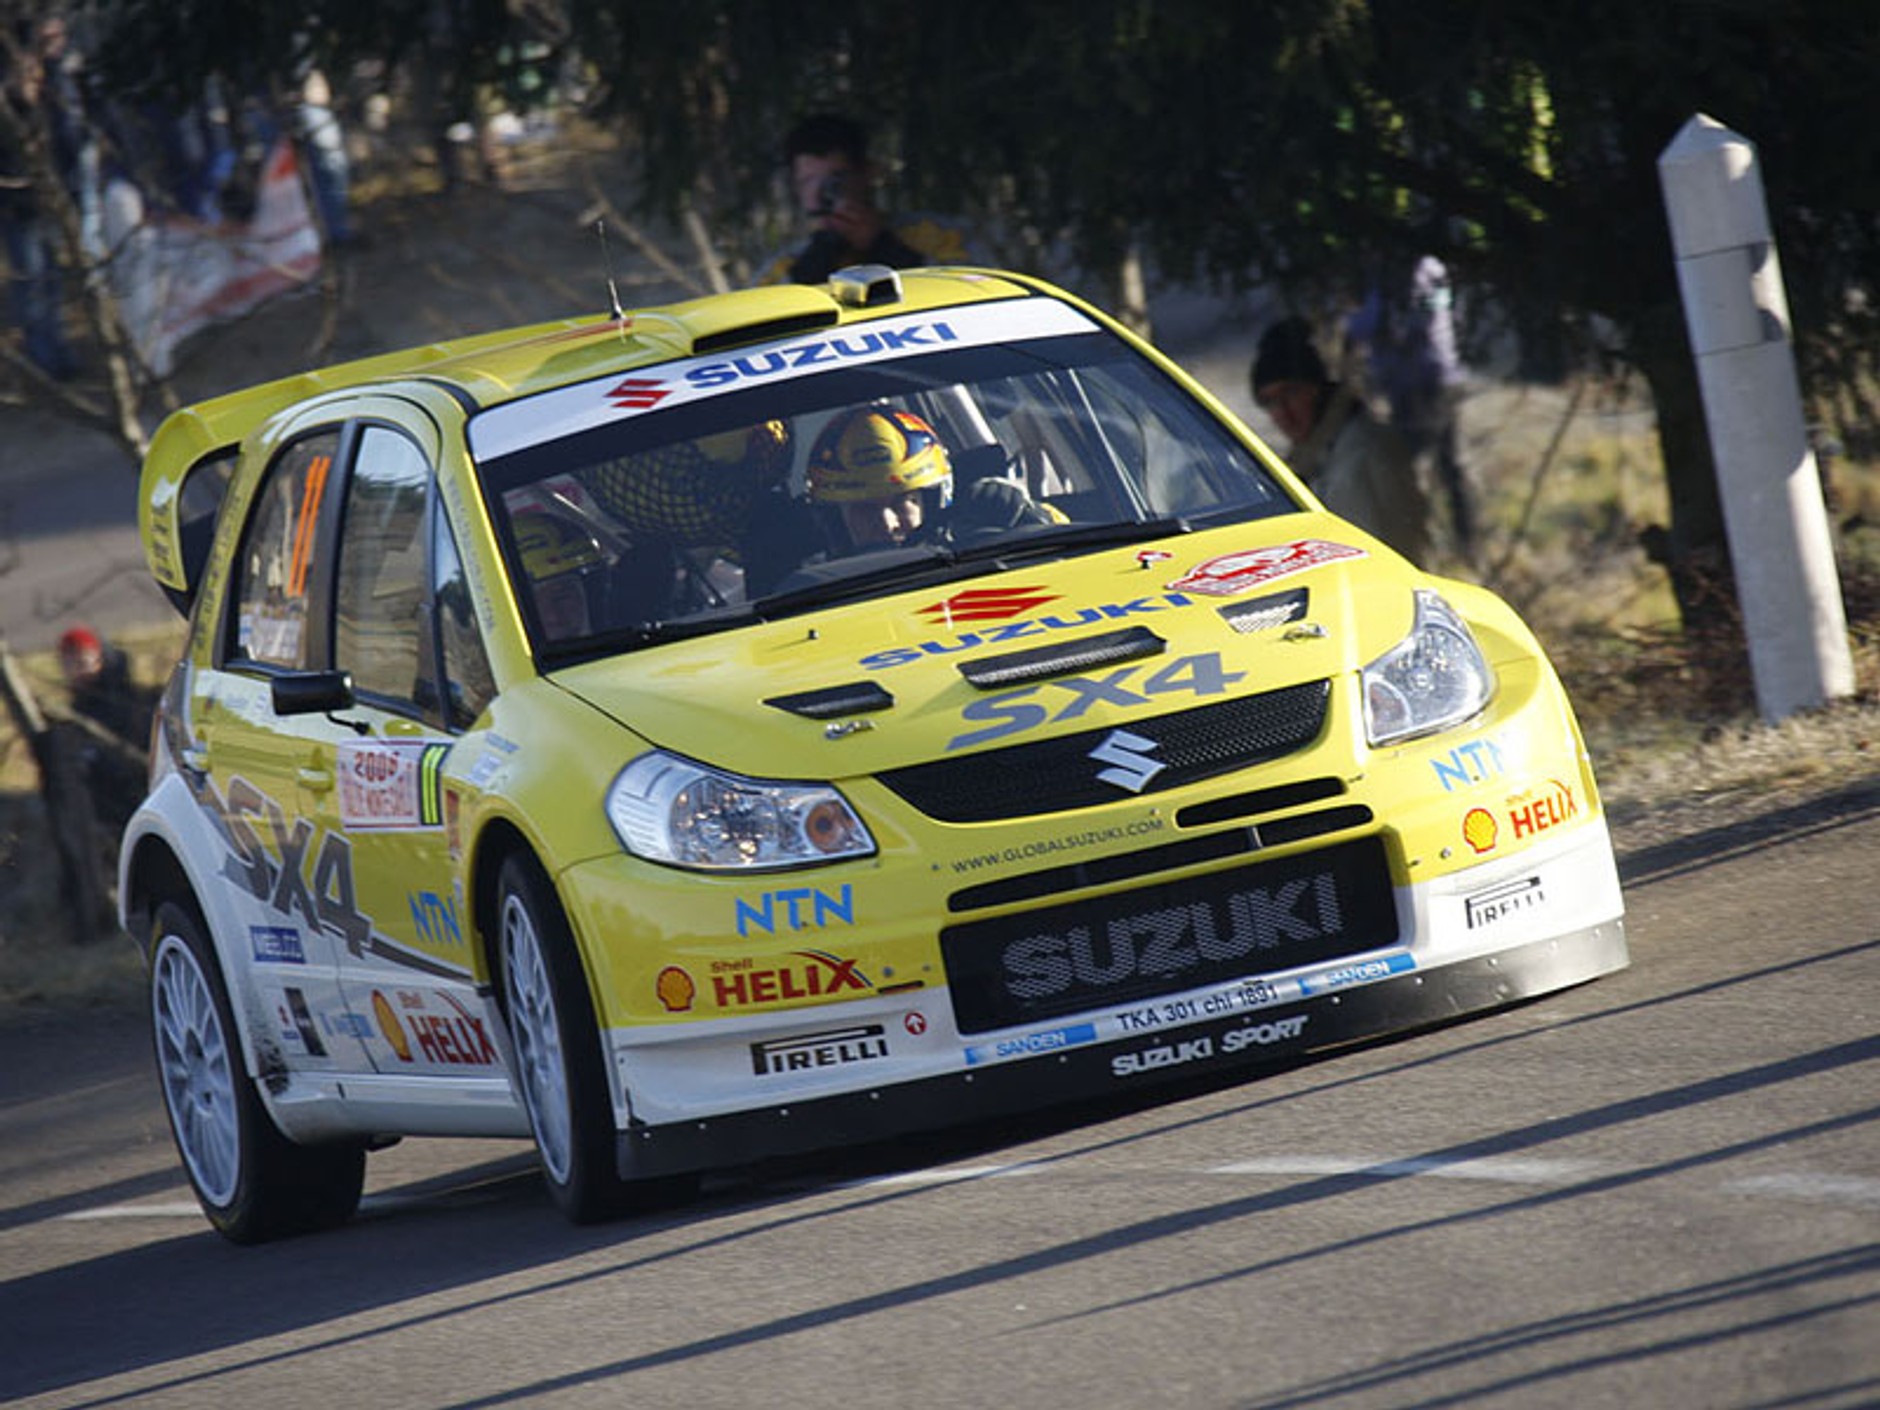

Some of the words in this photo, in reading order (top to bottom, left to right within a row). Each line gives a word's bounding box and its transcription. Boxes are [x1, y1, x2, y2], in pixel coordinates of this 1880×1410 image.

[685, 322, 958, 389] SUZUKI
[859, 594, 1196, 671] SUZUKI
[944, 651, 1246, 752] SX4
[1509, 786, 1578, 840] HELIX
[222, 774, 374, 961] SX4
[951, 817, 1165, 874] WWW.GLOBALSUZUKI.COM
[407, 891, 463, 946] NTN
[734, 883, 855, 937] NTN
[1002, 872, 1343, 1001] SUZUKI
[708, 959, 753, 974] Shell
[712, 958, 867, 1007] HELIX
[407, 1014, 498, 1066] HELIX
[1116, 1010, 1163, 1032] TKA
[1165, 1000, 1200, 1021] 301
[749, 1024, 890, 1076] PIRELLI
[996, 1031, 1067, 1058] SANDEN
[1111, 1036, 1214, 1077] SUZUKI
[1220, 1014, 1310, 1053] SPORT
